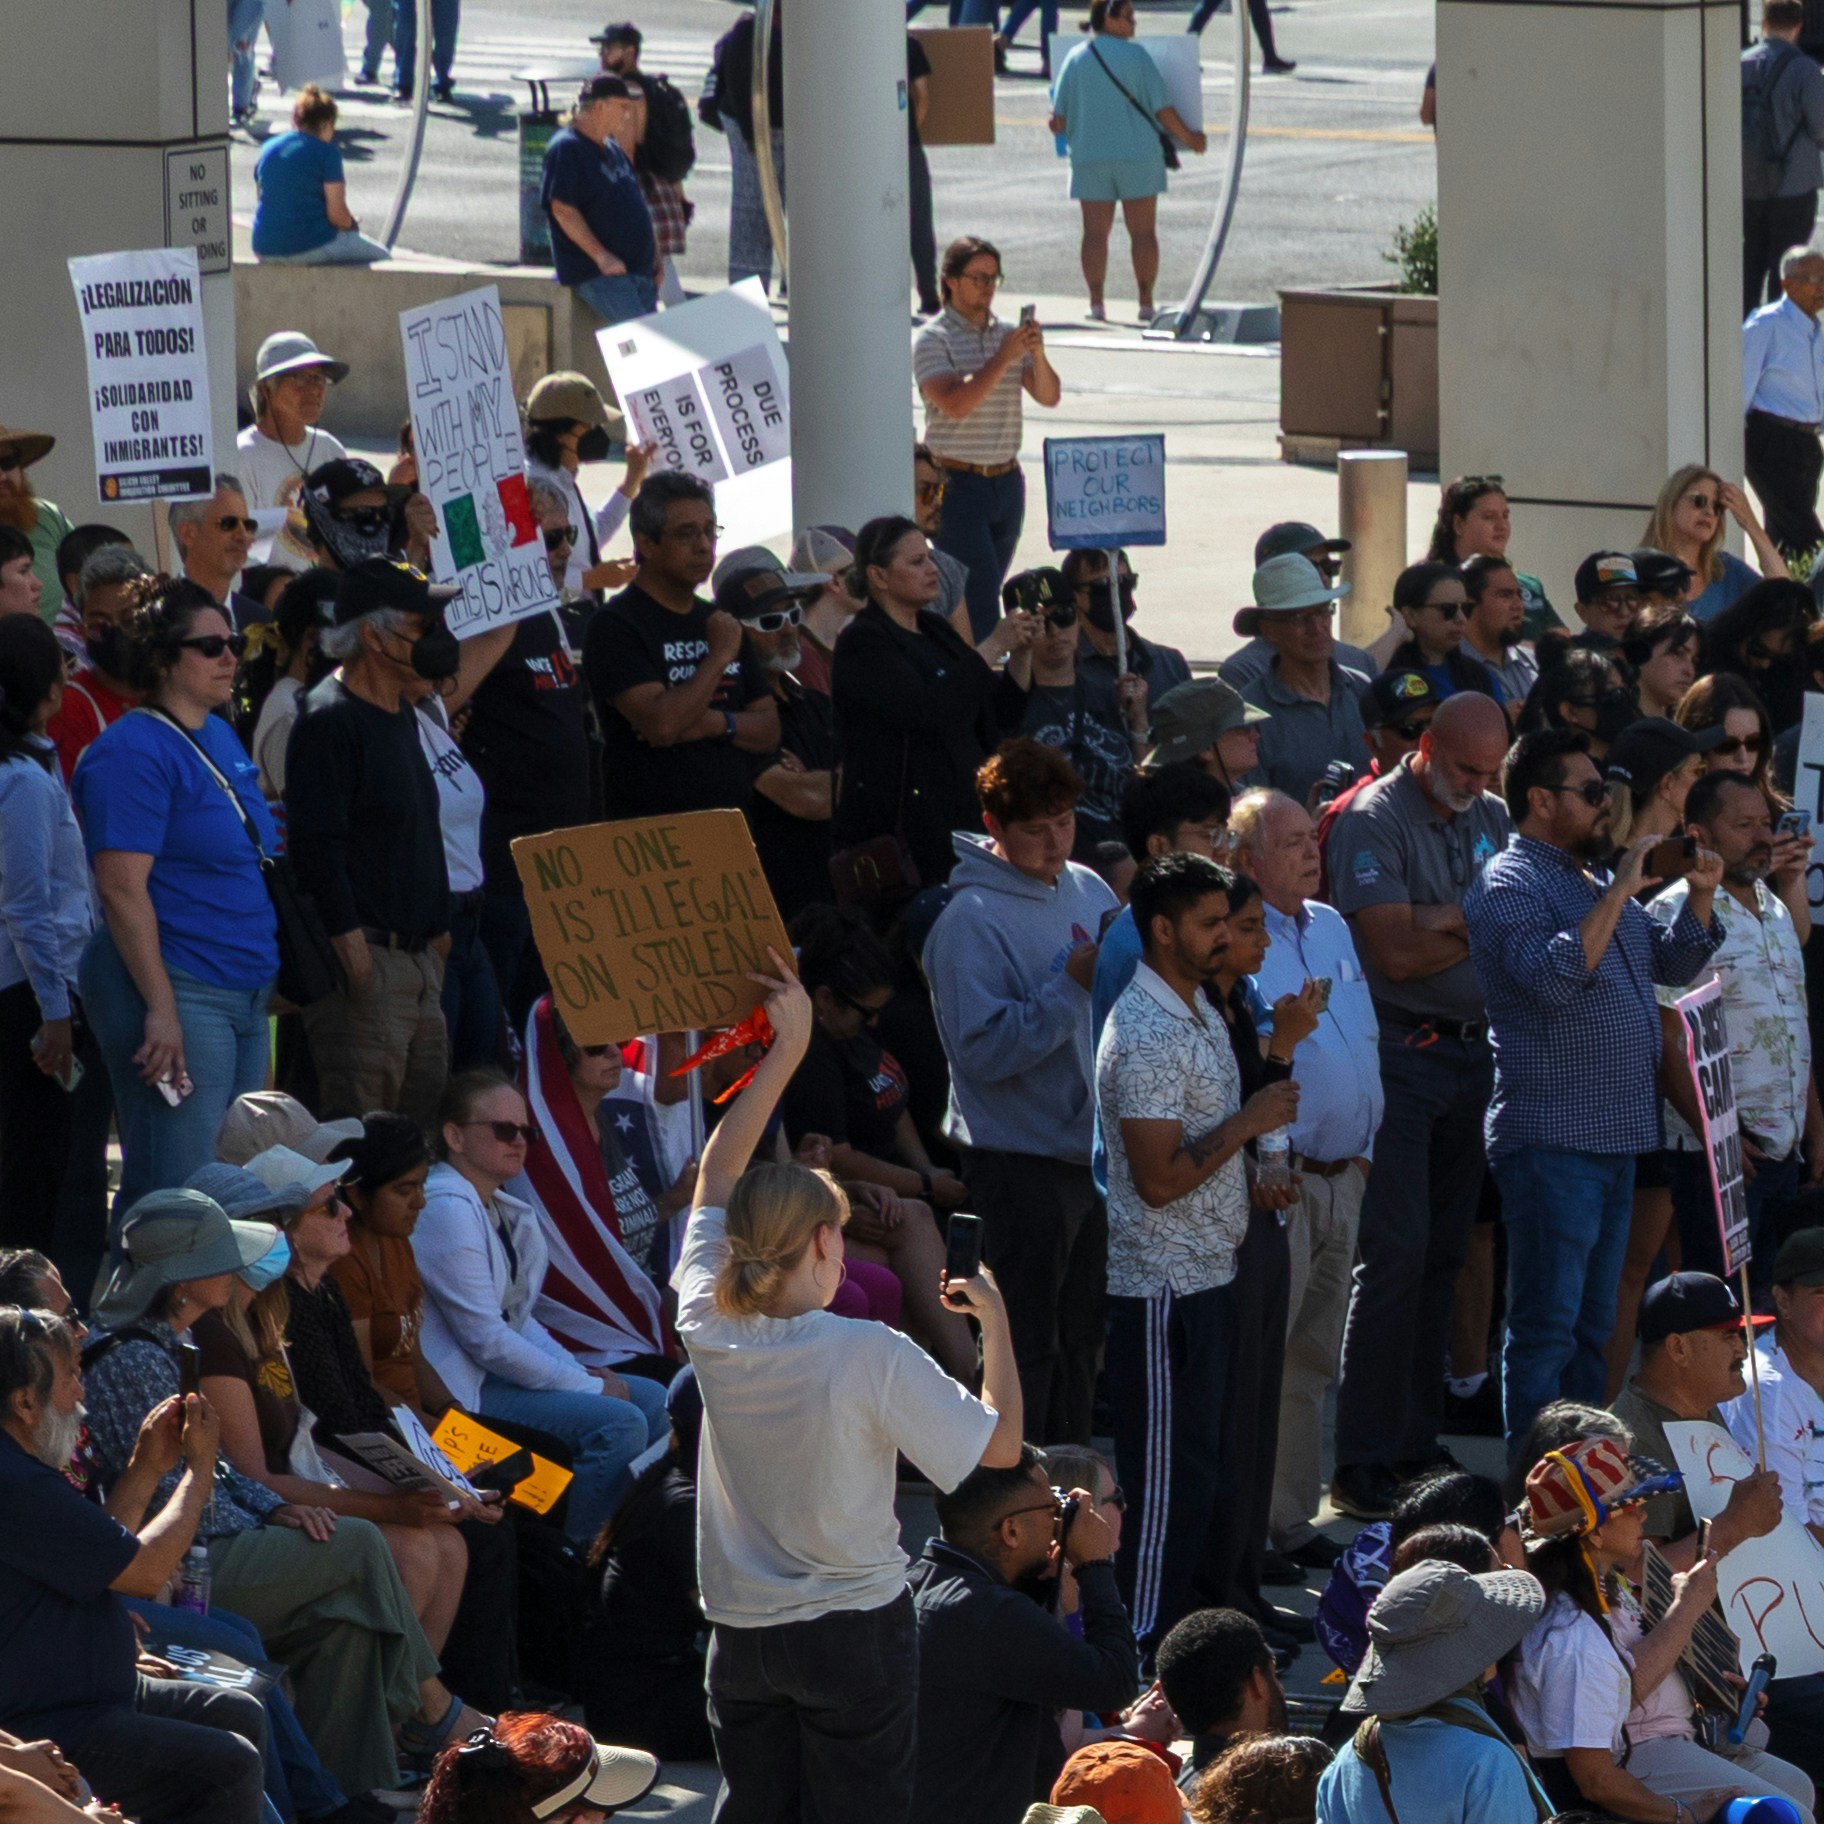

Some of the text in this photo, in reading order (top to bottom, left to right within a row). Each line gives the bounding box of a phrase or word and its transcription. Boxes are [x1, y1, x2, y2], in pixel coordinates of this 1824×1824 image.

[190, 165, 205, 181] NO
[179, 189, 218, 209] SITTING
[192, 219, 207, 235] OR
[81, 274, 192, 314] ¡LEGALIZACIÓN
[94, 327, 195, 359] PARA TODOS!
[437, 301, 506, 381] STAND
[95, 380, 193, 411] ¡SOLIDARIDAD
[675, 394, 692, 416] IS
[754, 381, 782, 428] DUE
[131, 411, 159, 432] CON
[714, 362, 764, 466] PROCESS
[104, 435, 203, 463] INMIGRANTES!
[428, 432, 521, 492] PEOPLE
[1055, 443, 1154, 476] PROTECT
[1083, 473, 1130, 497] OUR
[1056, 496, 1160, 518] NEIGHBORS
[533, 826, 691, 891] NO ONE
[551, 900, 595, 944] IS
[554, 924, 763, 1010] ON STOLEN
[629, 981, 737, 1031] LAND
